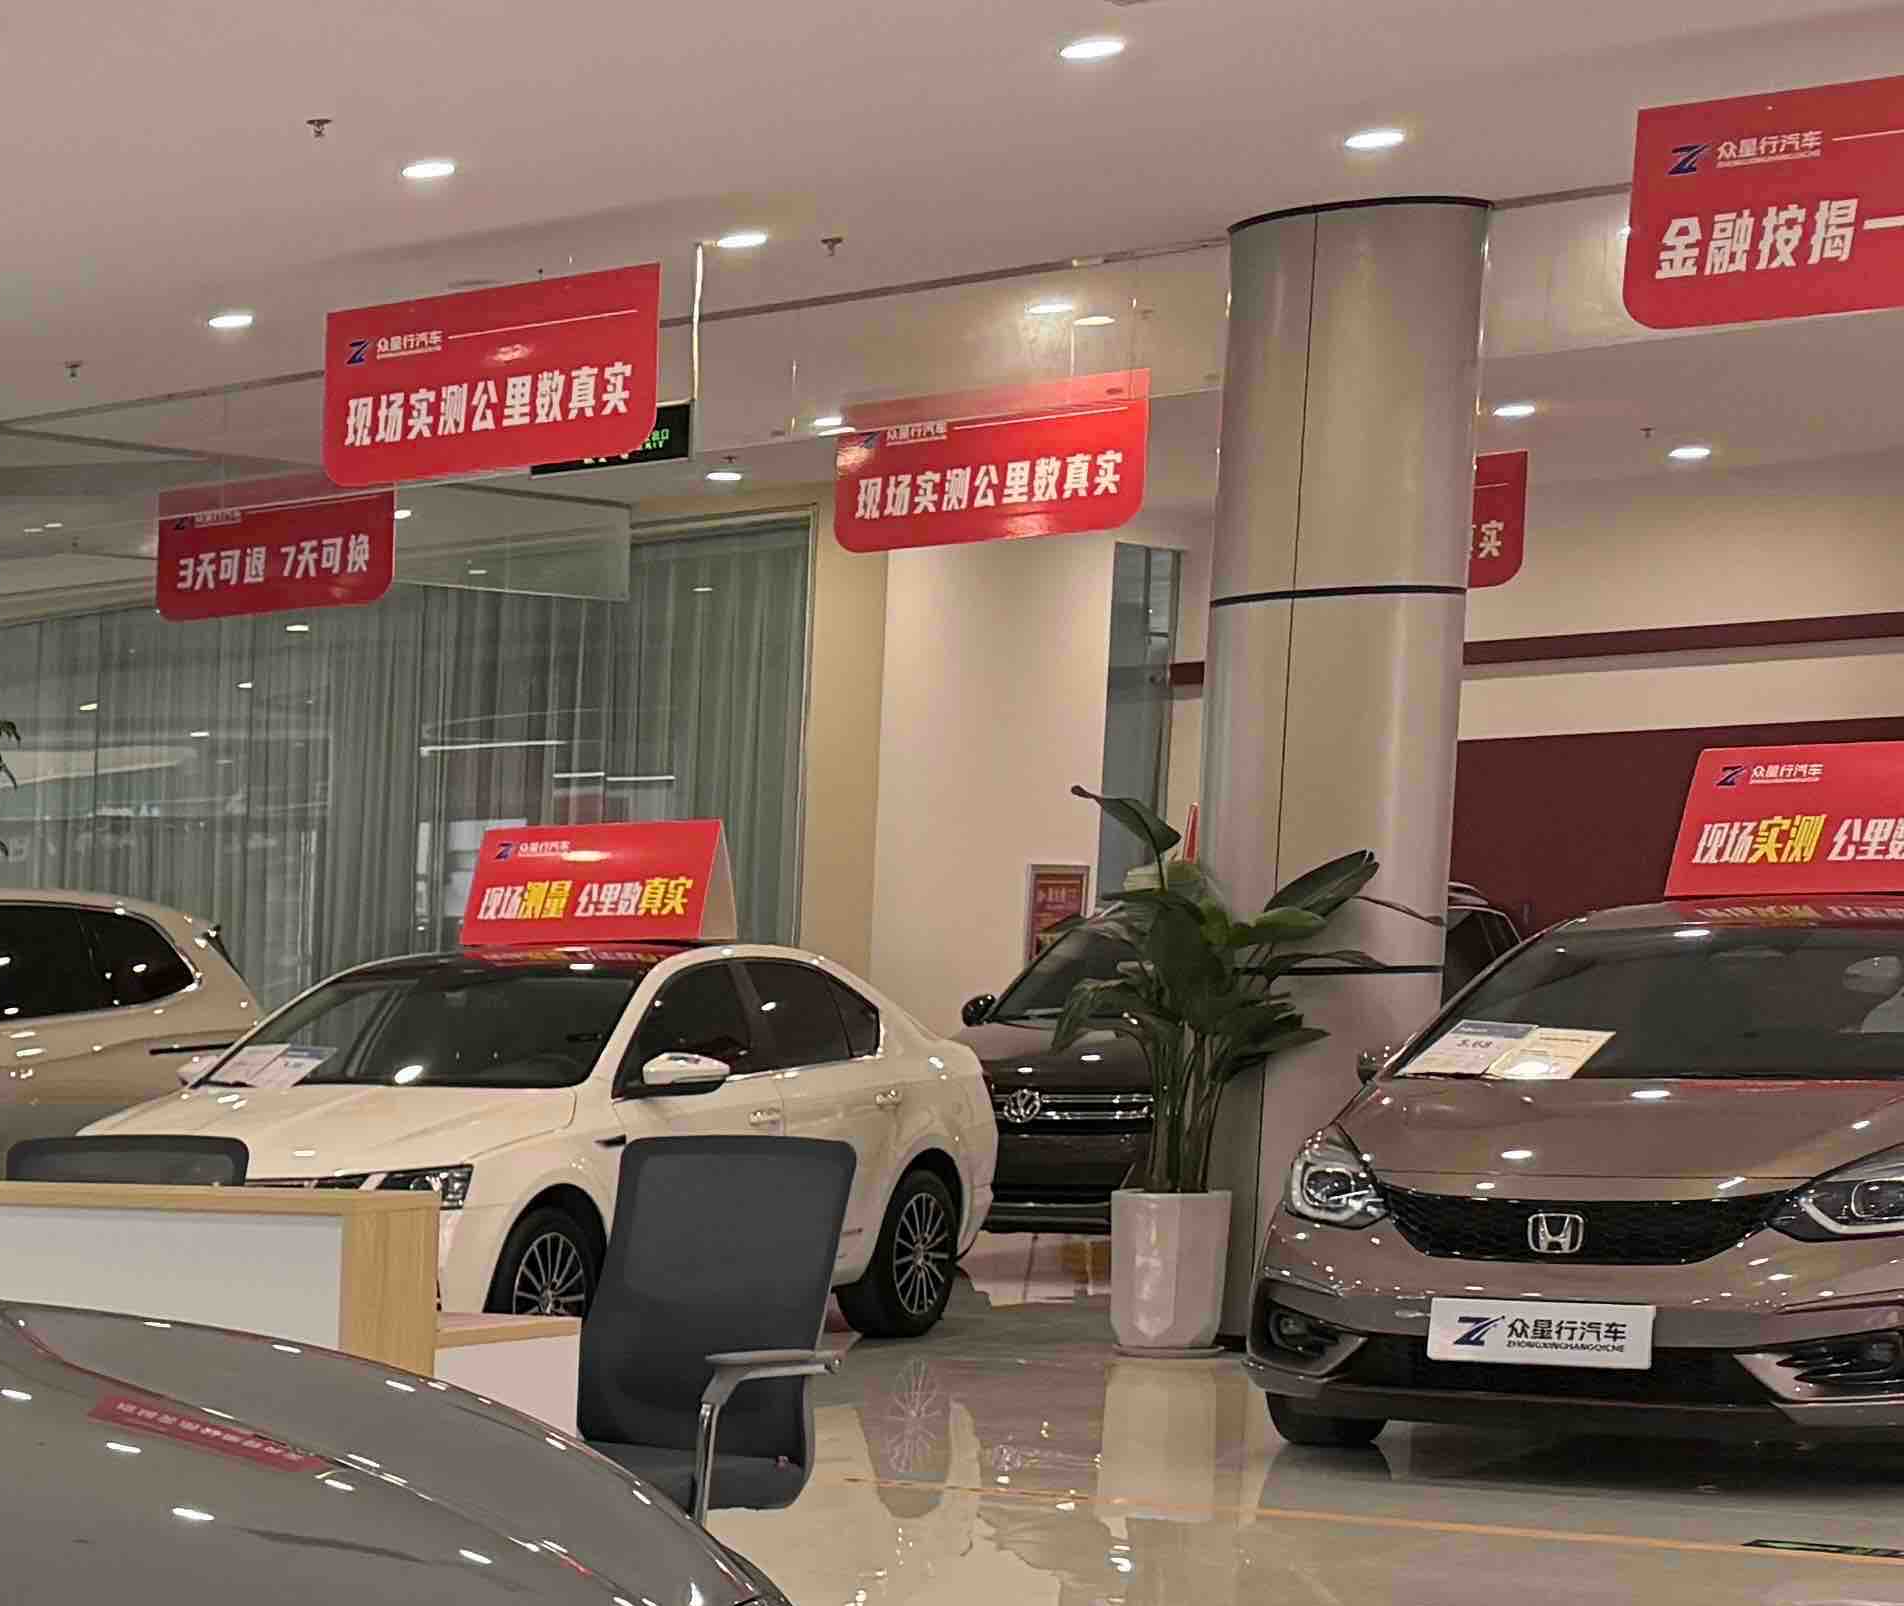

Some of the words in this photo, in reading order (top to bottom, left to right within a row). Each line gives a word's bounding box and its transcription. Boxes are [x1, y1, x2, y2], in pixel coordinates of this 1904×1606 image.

[1717, 130, 1823, 160] 众星行汽车
[344, 361, 632, 447] 现场实测公里数真实
[855, 450, 1124, 520] 现场实测公里数真实
[177, 546, 266, 590] 3天可退
[280, 533, 370, 579] 7天可换
[1473, 520, 1504, 559] 实
[1692, 815, 1827, 864] 现场实测
[477, 880, 572, 920] 现场测量
[574, 876, 694, 918] 公里数真实
[1507, 1318, 1627, 1341] 众星行汽车
